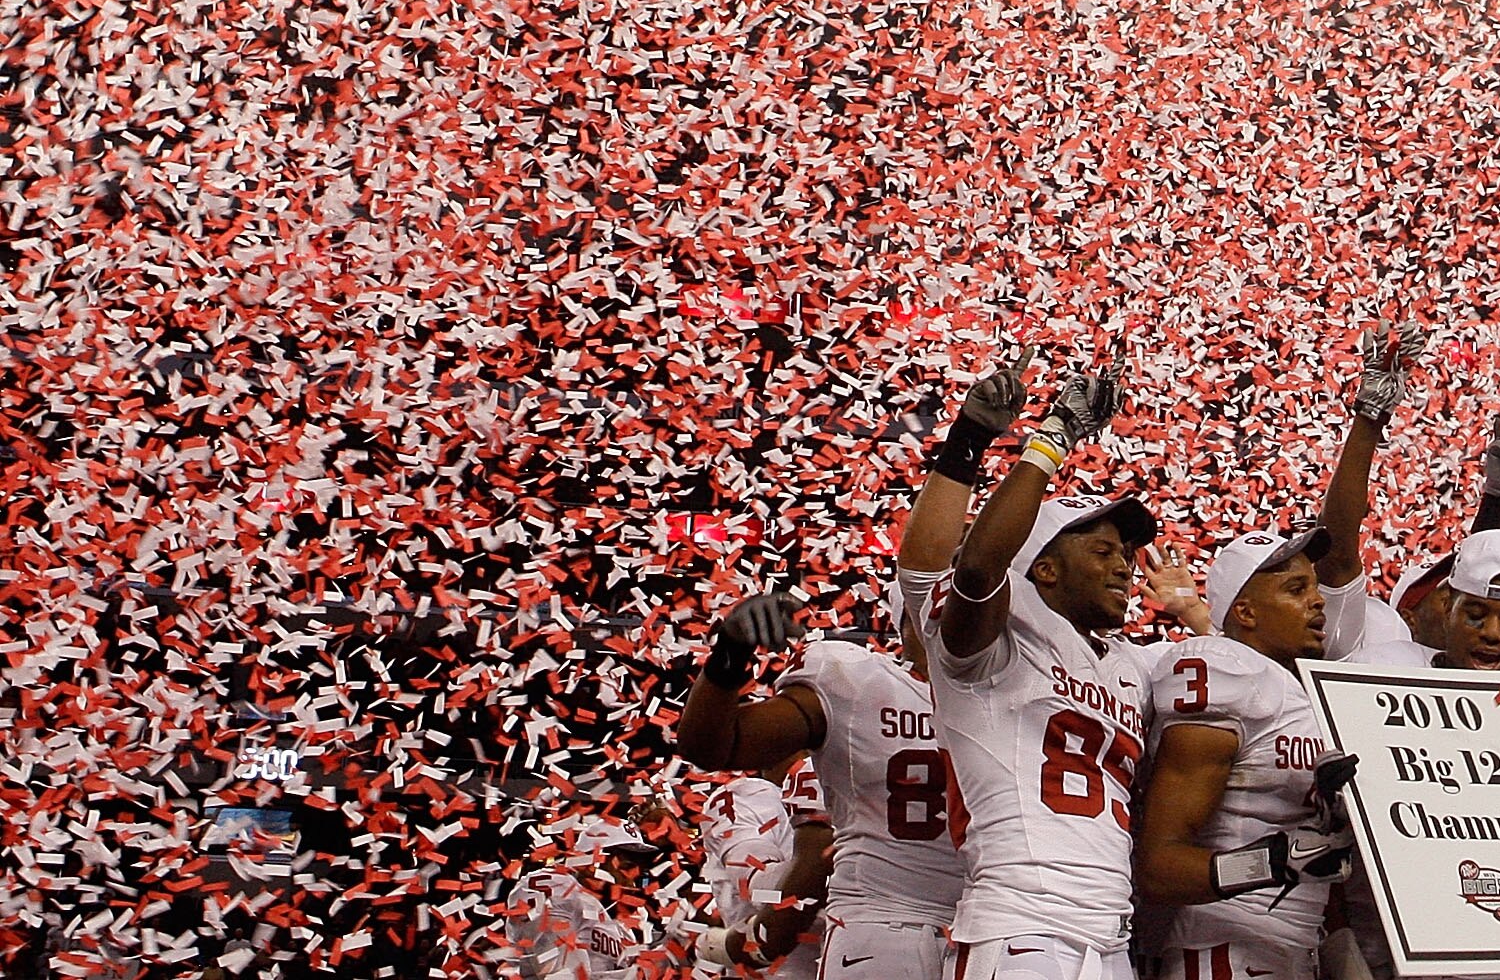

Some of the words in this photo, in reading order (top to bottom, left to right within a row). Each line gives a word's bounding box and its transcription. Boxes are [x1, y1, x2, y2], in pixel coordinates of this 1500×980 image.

[1173, 657, 1209, 714] 3
[1376, 692, 1483, 731] 2010
[1040, 709, 1143, 832] 85
[1385, 746, 1461, 794] Big
[1464, 880, 1497, 894] BIG
